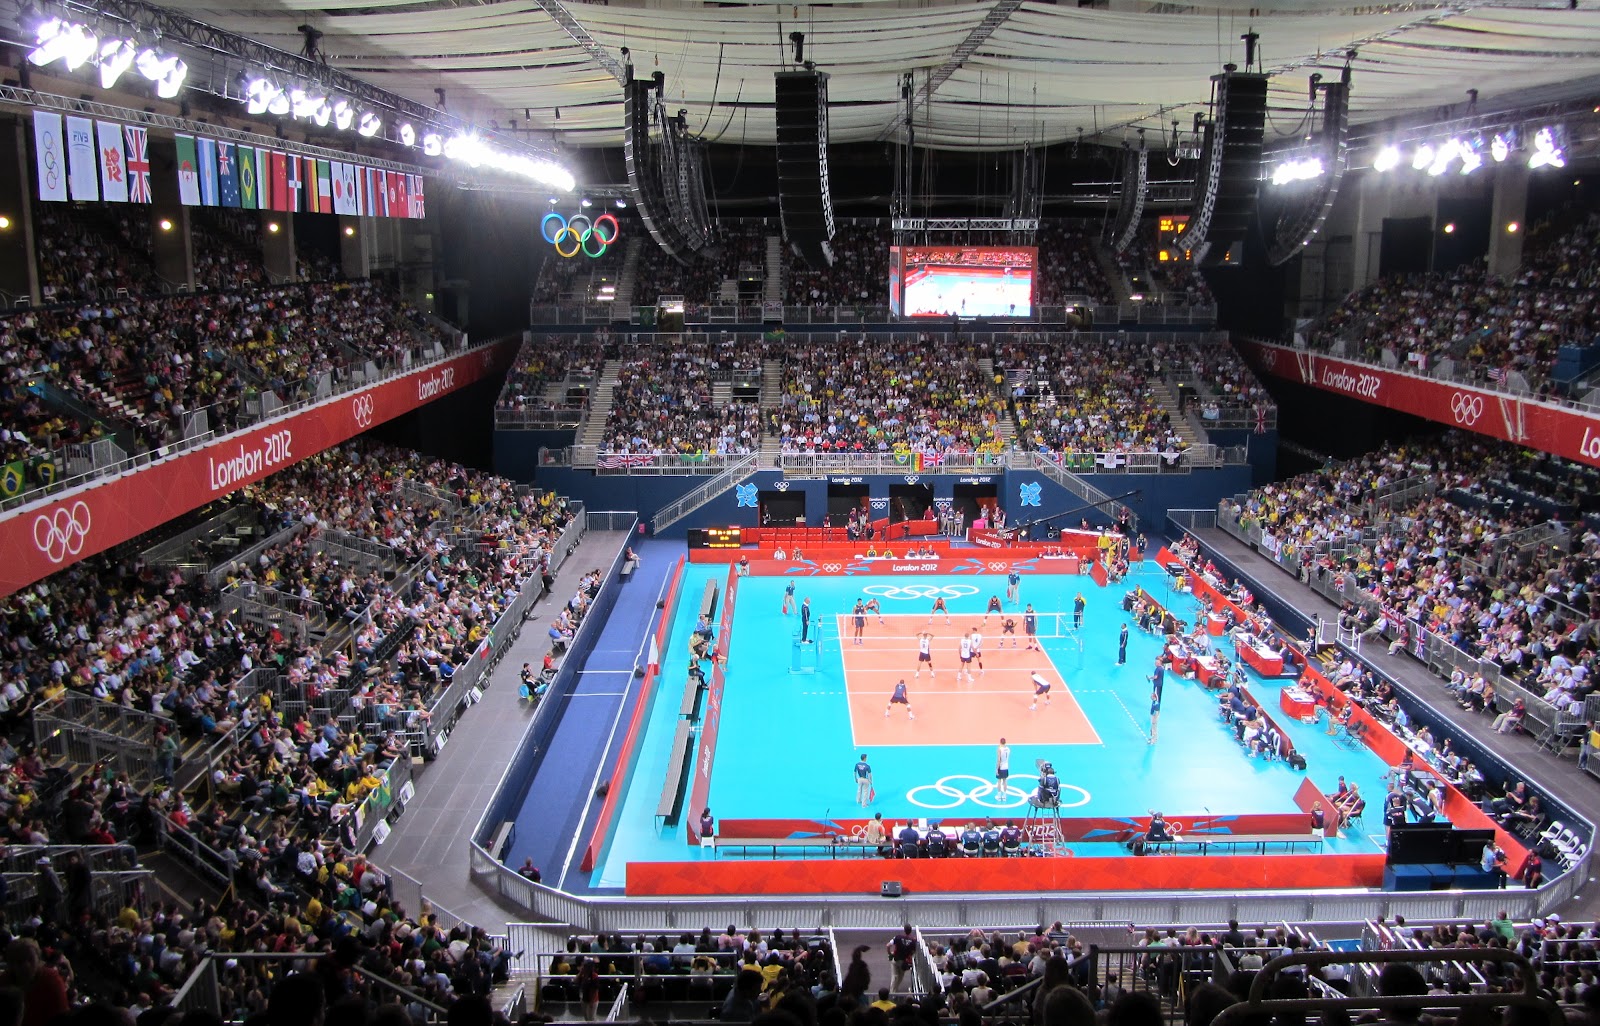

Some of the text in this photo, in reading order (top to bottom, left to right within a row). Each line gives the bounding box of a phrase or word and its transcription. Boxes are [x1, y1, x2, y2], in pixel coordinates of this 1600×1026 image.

[418, 366, 455, 401] London 2012
[1321, 365, 1381, 399] London 2012
[209, 429, 292, 491] London 2012
[892, 563, 938, 572] London 2012
